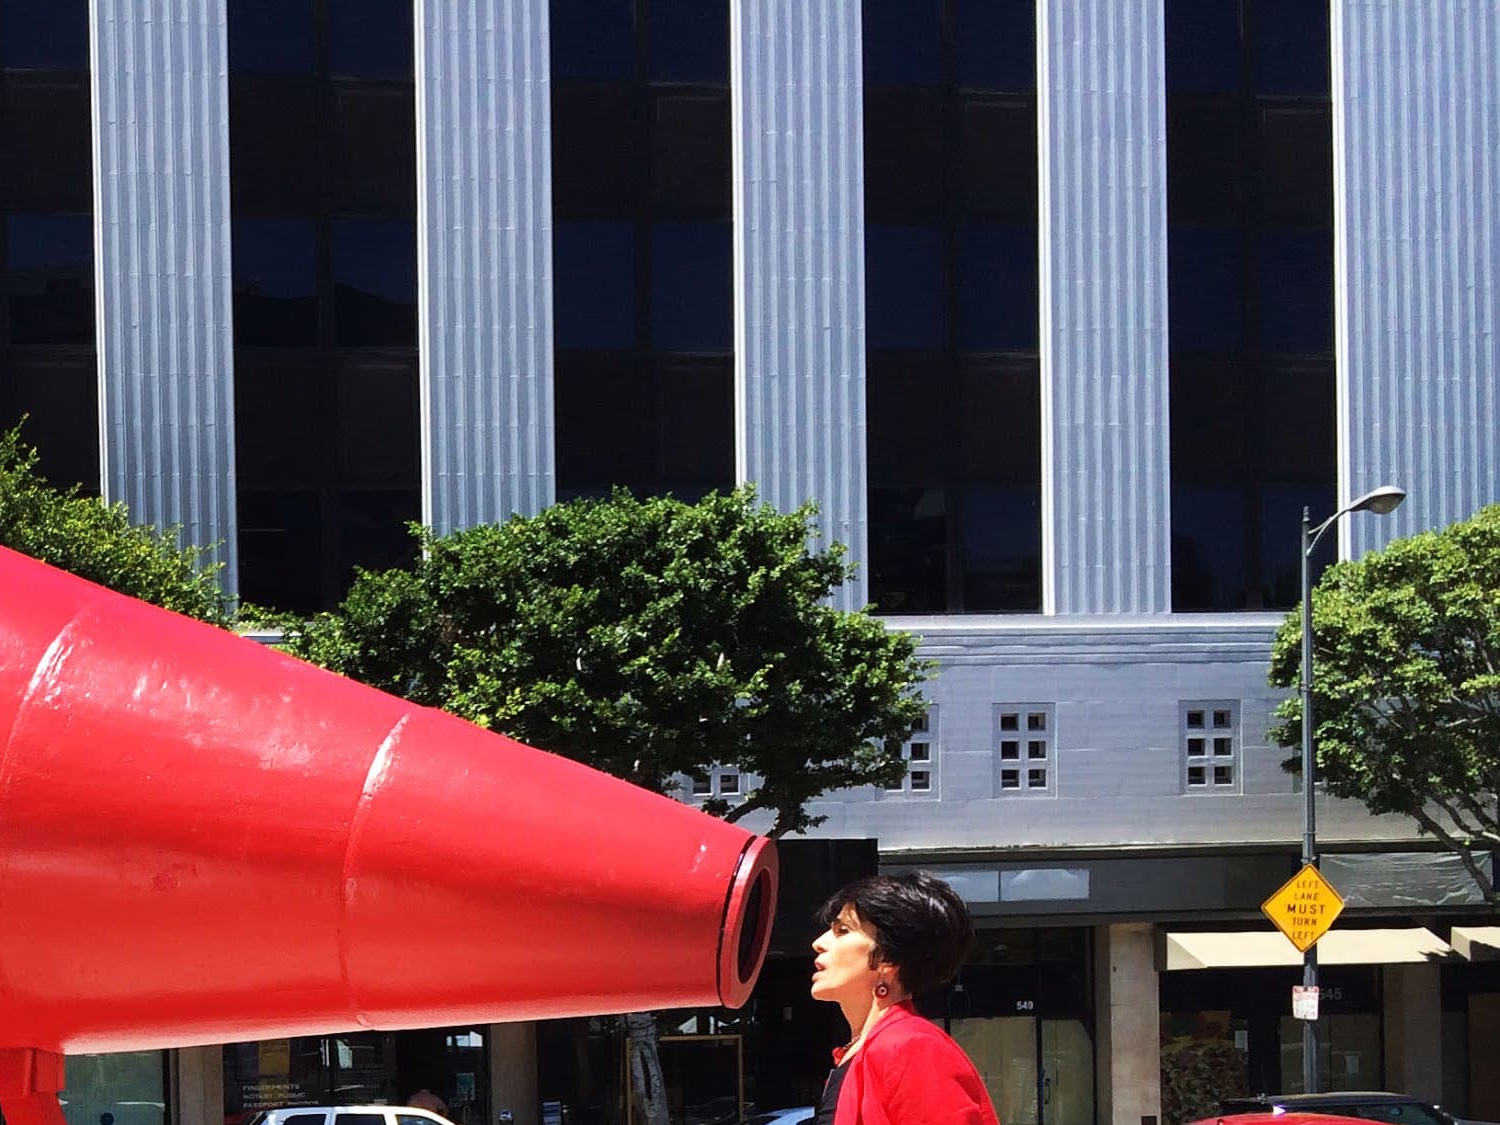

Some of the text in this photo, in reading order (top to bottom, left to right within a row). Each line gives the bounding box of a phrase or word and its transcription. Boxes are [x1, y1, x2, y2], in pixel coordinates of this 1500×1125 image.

[1297, 880, 1319, 889] LEFT
[1294, 892, 1320, 901] LANE
[1287, 903, 1326, 915] MUST
[1292, 917, 1317, 926] TURN
[1292, 931, 1315, 940] LEFT
[1016, 1000, 1034, 1011] 549
